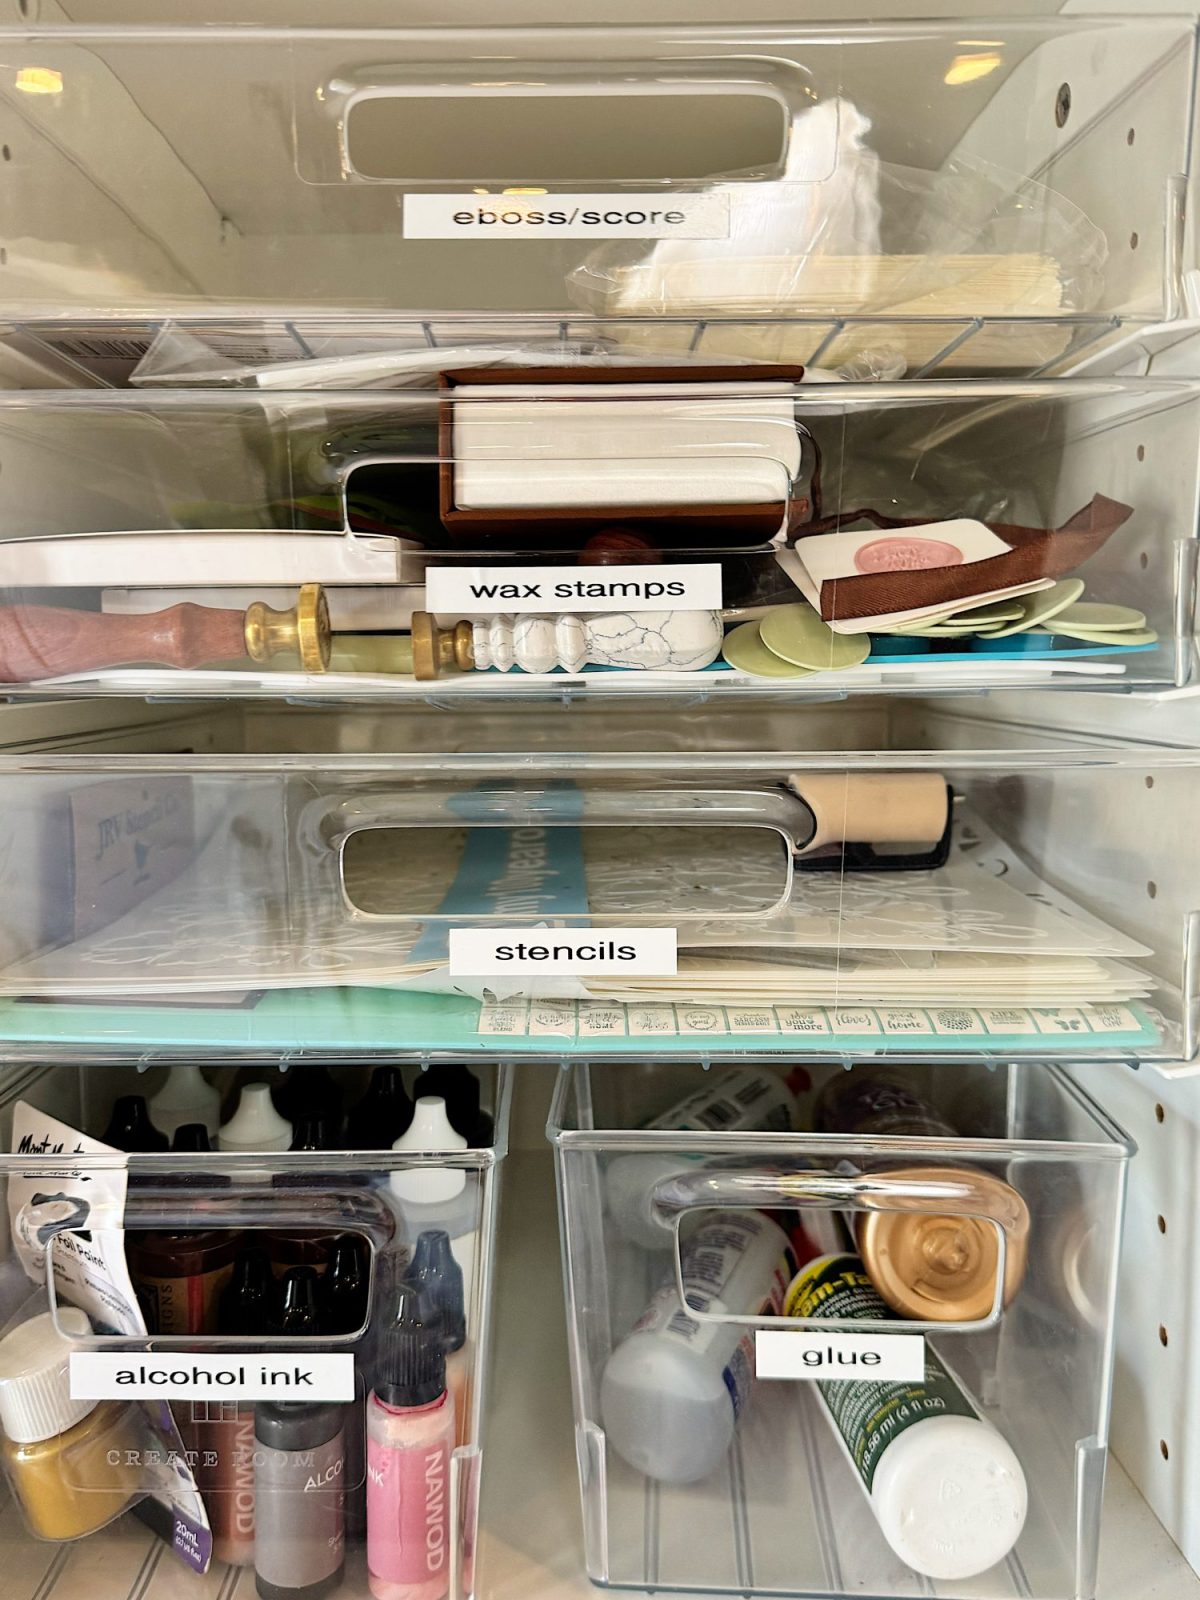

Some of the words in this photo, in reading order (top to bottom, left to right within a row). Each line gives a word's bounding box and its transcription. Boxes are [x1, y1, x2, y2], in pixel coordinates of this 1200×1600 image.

[453, 208, 686, 225] eboss/score
[469, 584, 541, 598] wax
[554, 580, 686, 600] stamps
[495, 942, 637, 960] stencils
[802, 1346, 881, 1367] glue
[115, 1366, 245, 1385] alcohol
[260, 1367, 313, 1385] ink
[106, 1450, 219, 1466] CREATE
[425, 1450, 444, 1572] NAWOD
[176, 1521, 199, 1547] 20mL
